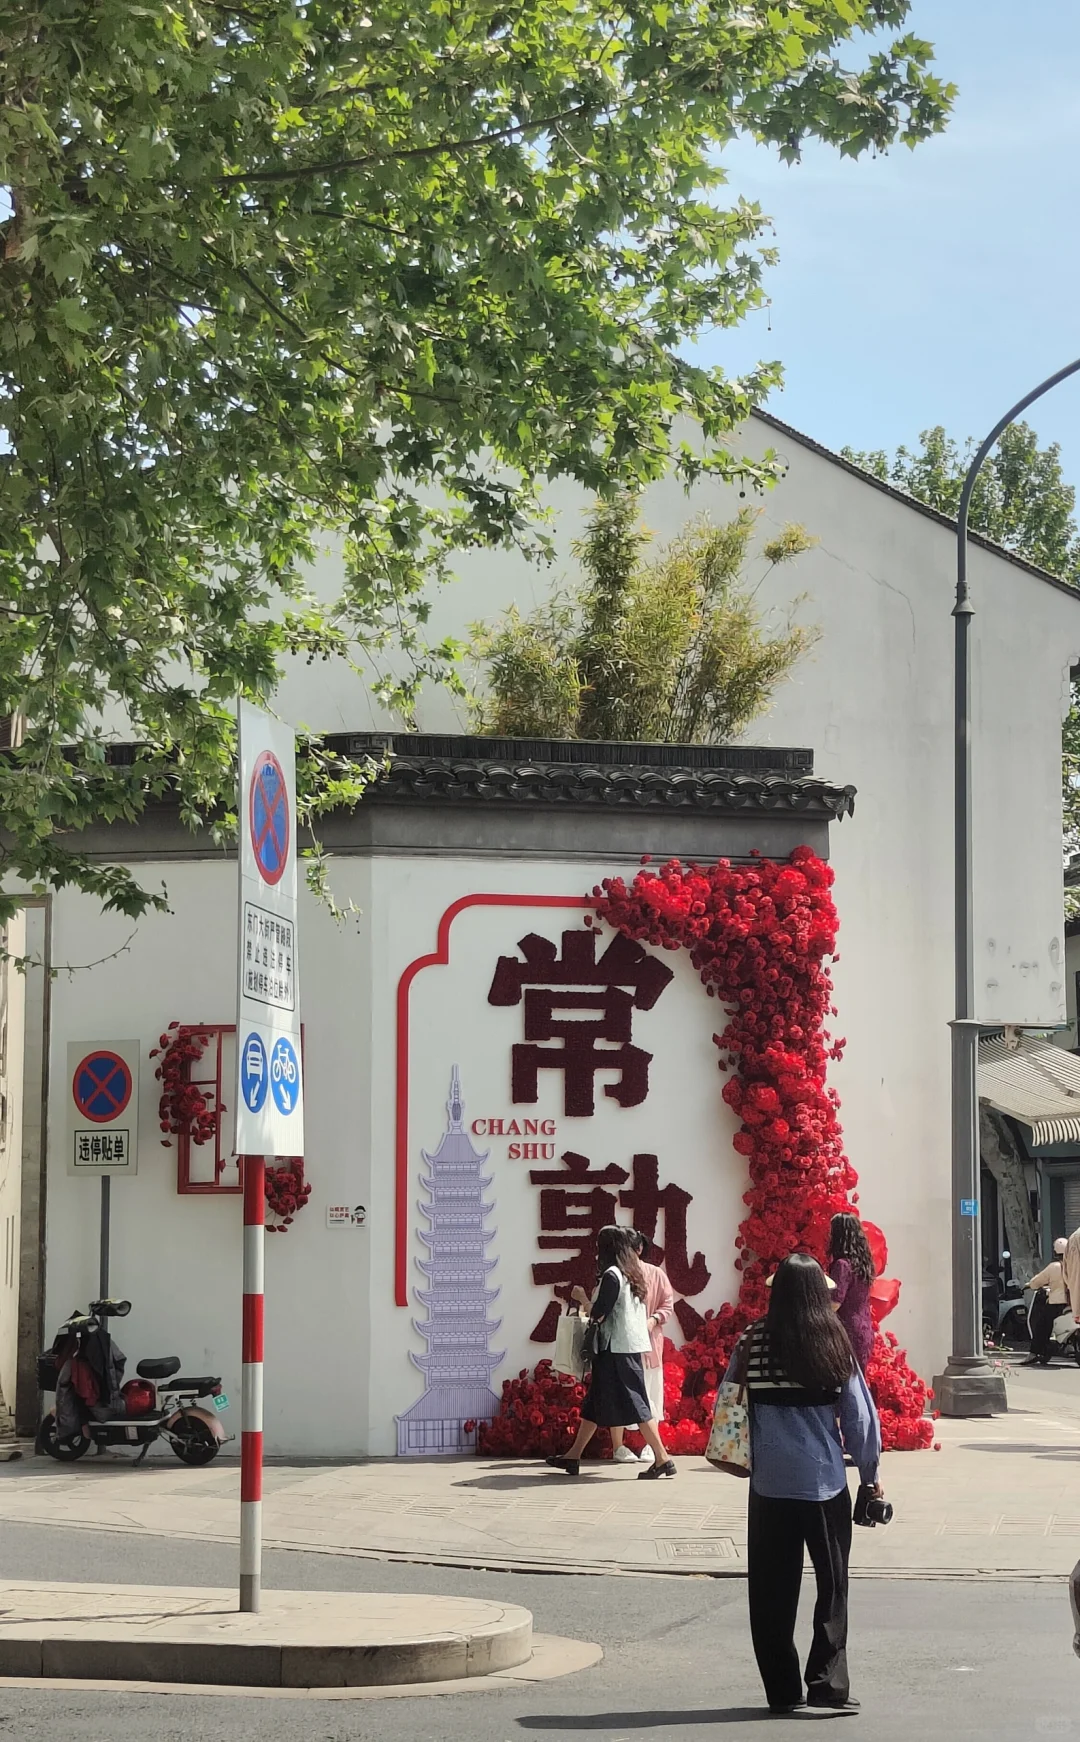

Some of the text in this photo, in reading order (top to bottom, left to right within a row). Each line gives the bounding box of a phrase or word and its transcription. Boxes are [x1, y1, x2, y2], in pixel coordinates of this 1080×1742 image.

[471, 1118, 557, 1136] CHANG
[79, 1135, 125, 1162] 违停贴单
[508, 1142, 556, 1160] SHU
